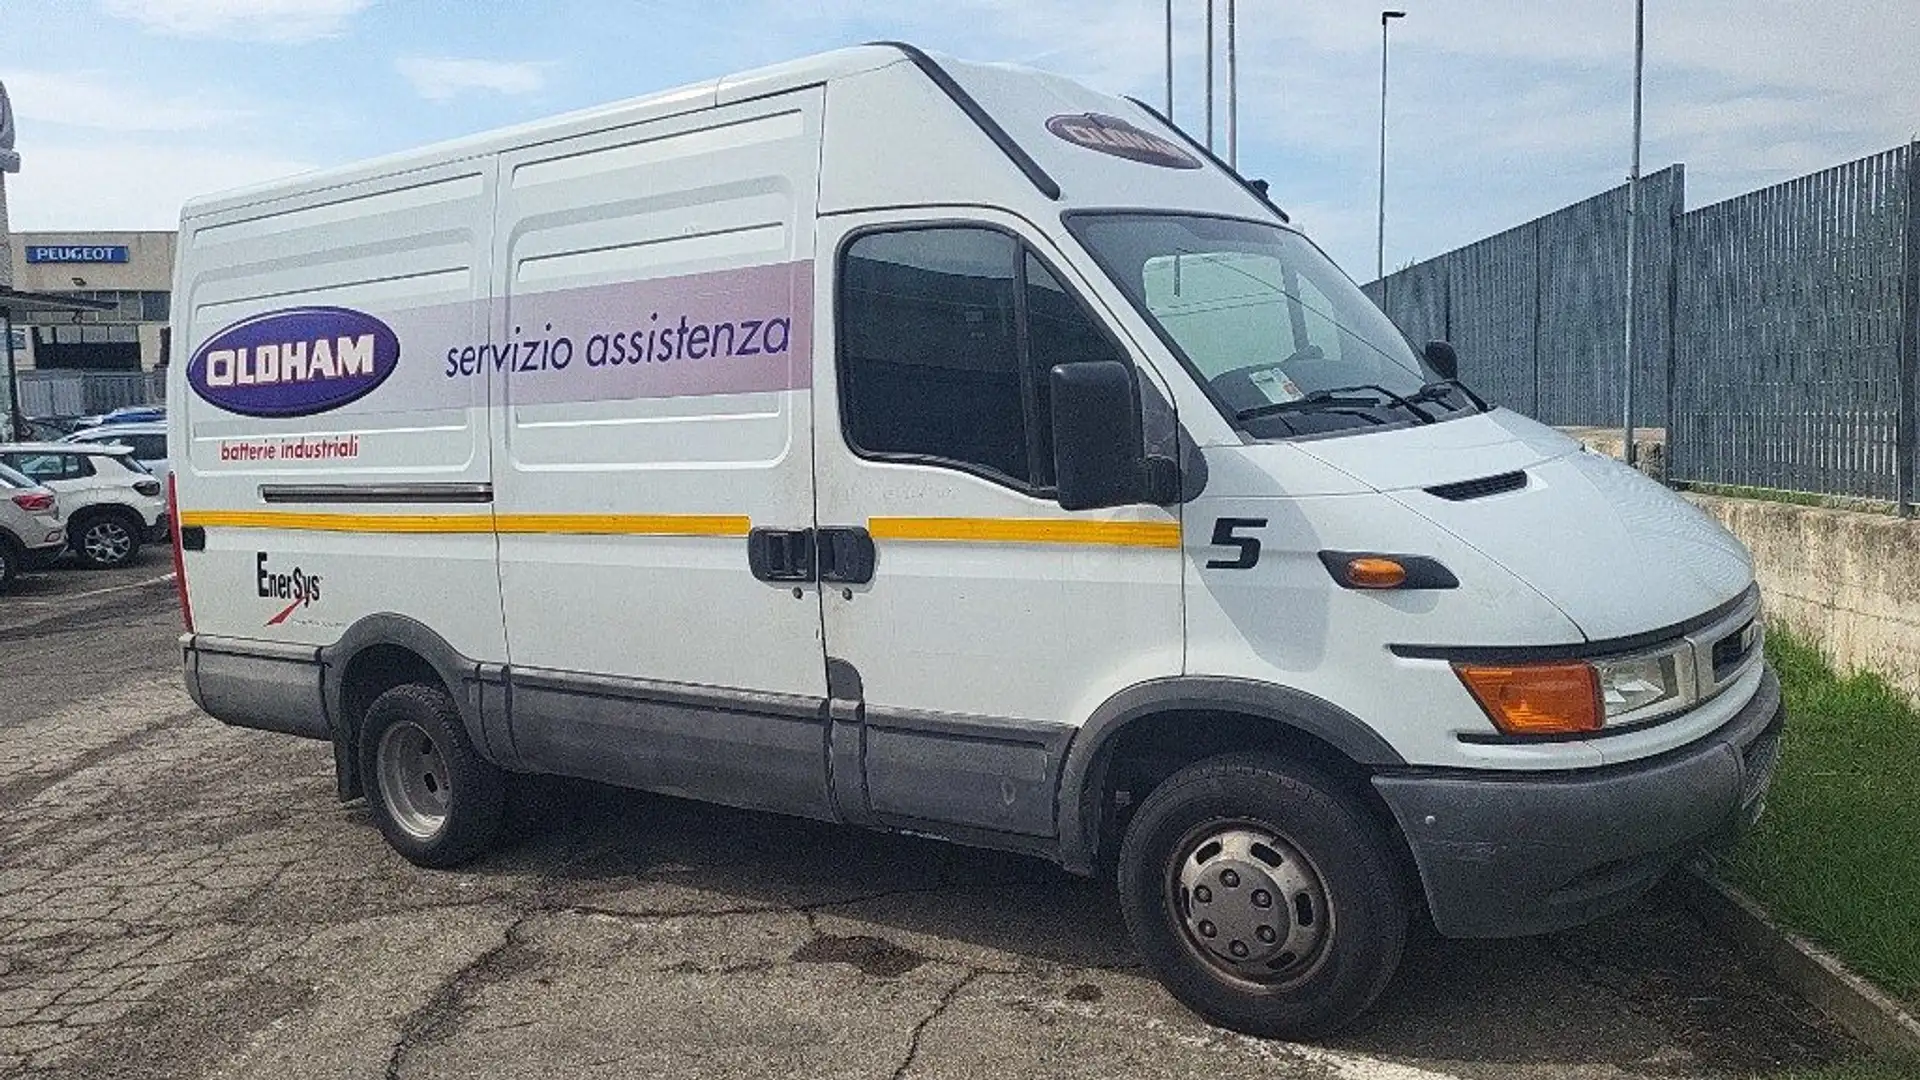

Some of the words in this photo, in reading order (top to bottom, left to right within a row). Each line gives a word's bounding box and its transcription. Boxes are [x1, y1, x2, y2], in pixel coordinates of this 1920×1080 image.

[37, 246, 115, 261] PEUGEOT
[206, 334, 374, 388] OLDHAM
[446, 324, 573, 377] servizio
[586, 312, 791, 366] assistenza
[221, 440, 276, 461] batterie
[280, 435, 359, 459] industriali
[1206, 518, 1268, 569] 5
[257, 552, 321, 608] EnerSys
